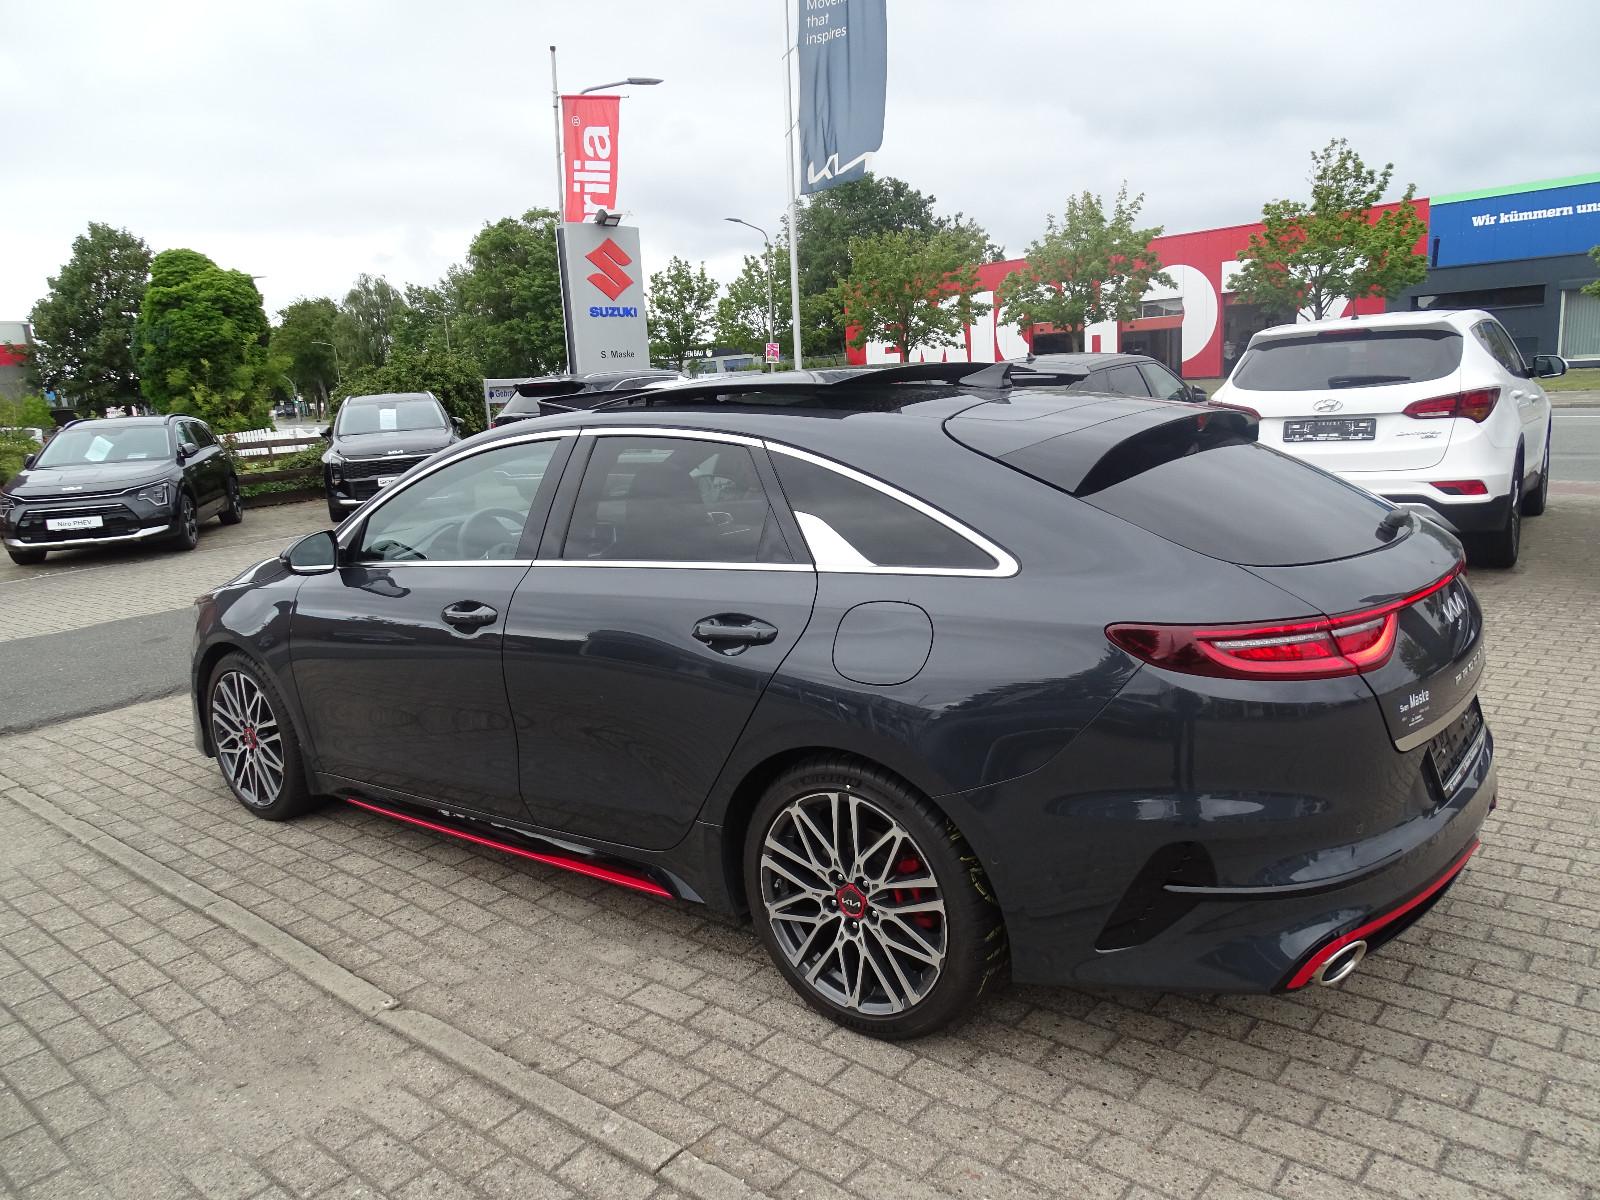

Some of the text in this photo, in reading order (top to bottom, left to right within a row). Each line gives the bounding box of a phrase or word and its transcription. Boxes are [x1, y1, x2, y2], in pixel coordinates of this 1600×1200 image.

[806, 13, 829, 28] that
[806, 26, 847, 45] inspires
[573, 126, 611, 223] rilia
[1472, 213, 1497, 227] Wir
[1499, 206, 1573, 223] kümmern
[589, 306, 638, 318] SUZUKI
[610, 349, 635, 359] Maske
[1409, 689, 1430, 709] Maske
